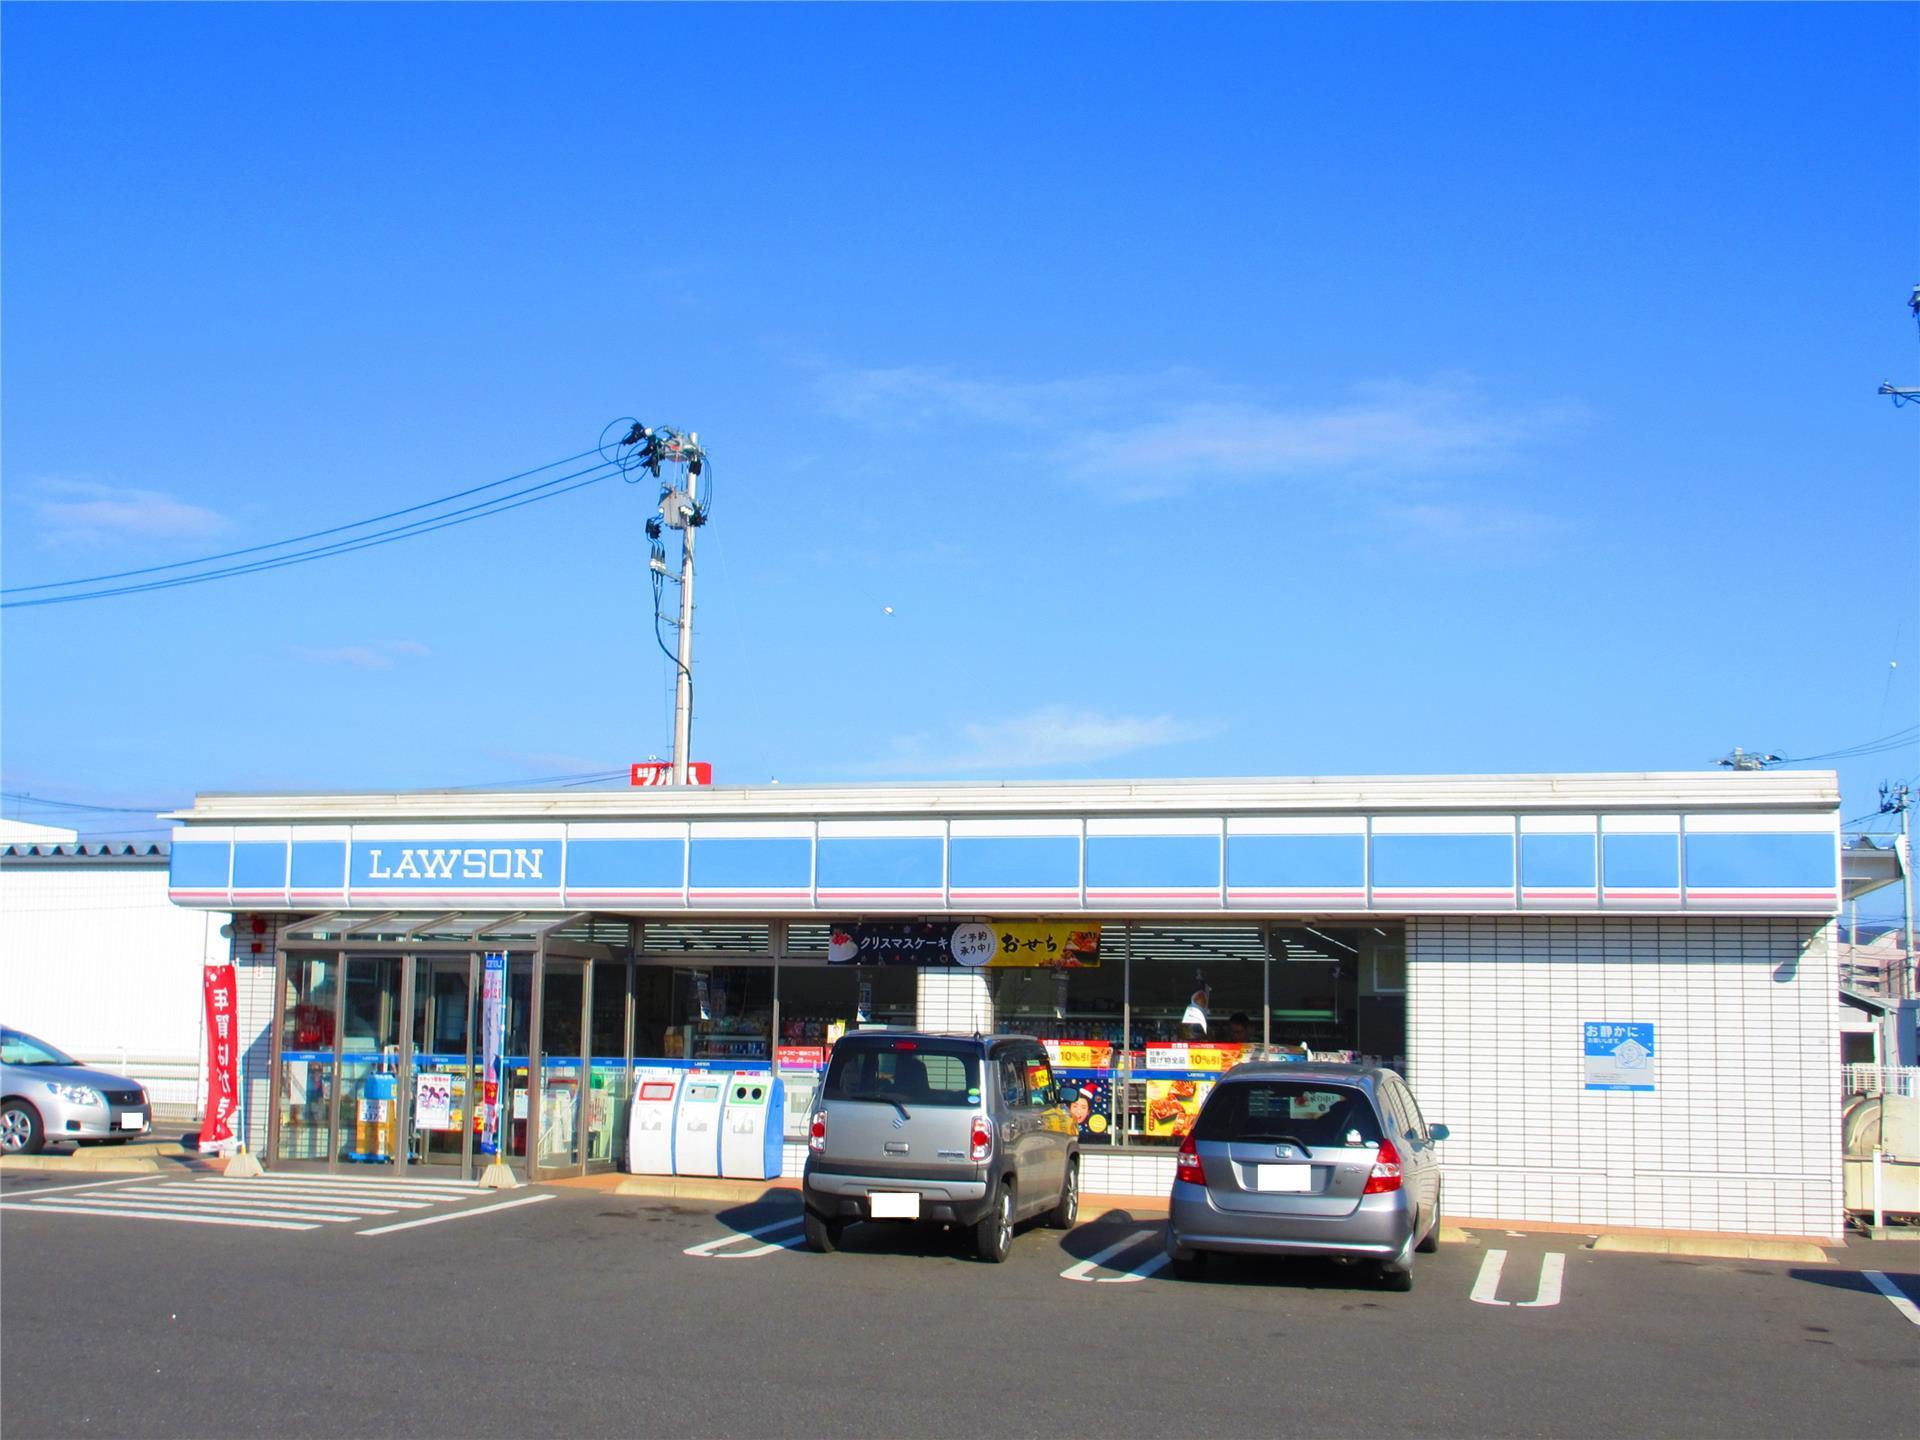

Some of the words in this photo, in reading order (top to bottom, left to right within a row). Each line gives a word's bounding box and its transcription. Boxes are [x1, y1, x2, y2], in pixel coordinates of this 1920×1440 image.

[368, 848, 544, 880] LAWSON
[860, 935, 949, 950] クリスマスケーキ
[959, 931, 988, 944] ご予約
[1001, 932, 1058, 954] おせち
[1585, 1025, 1640, 1038] お静かに
